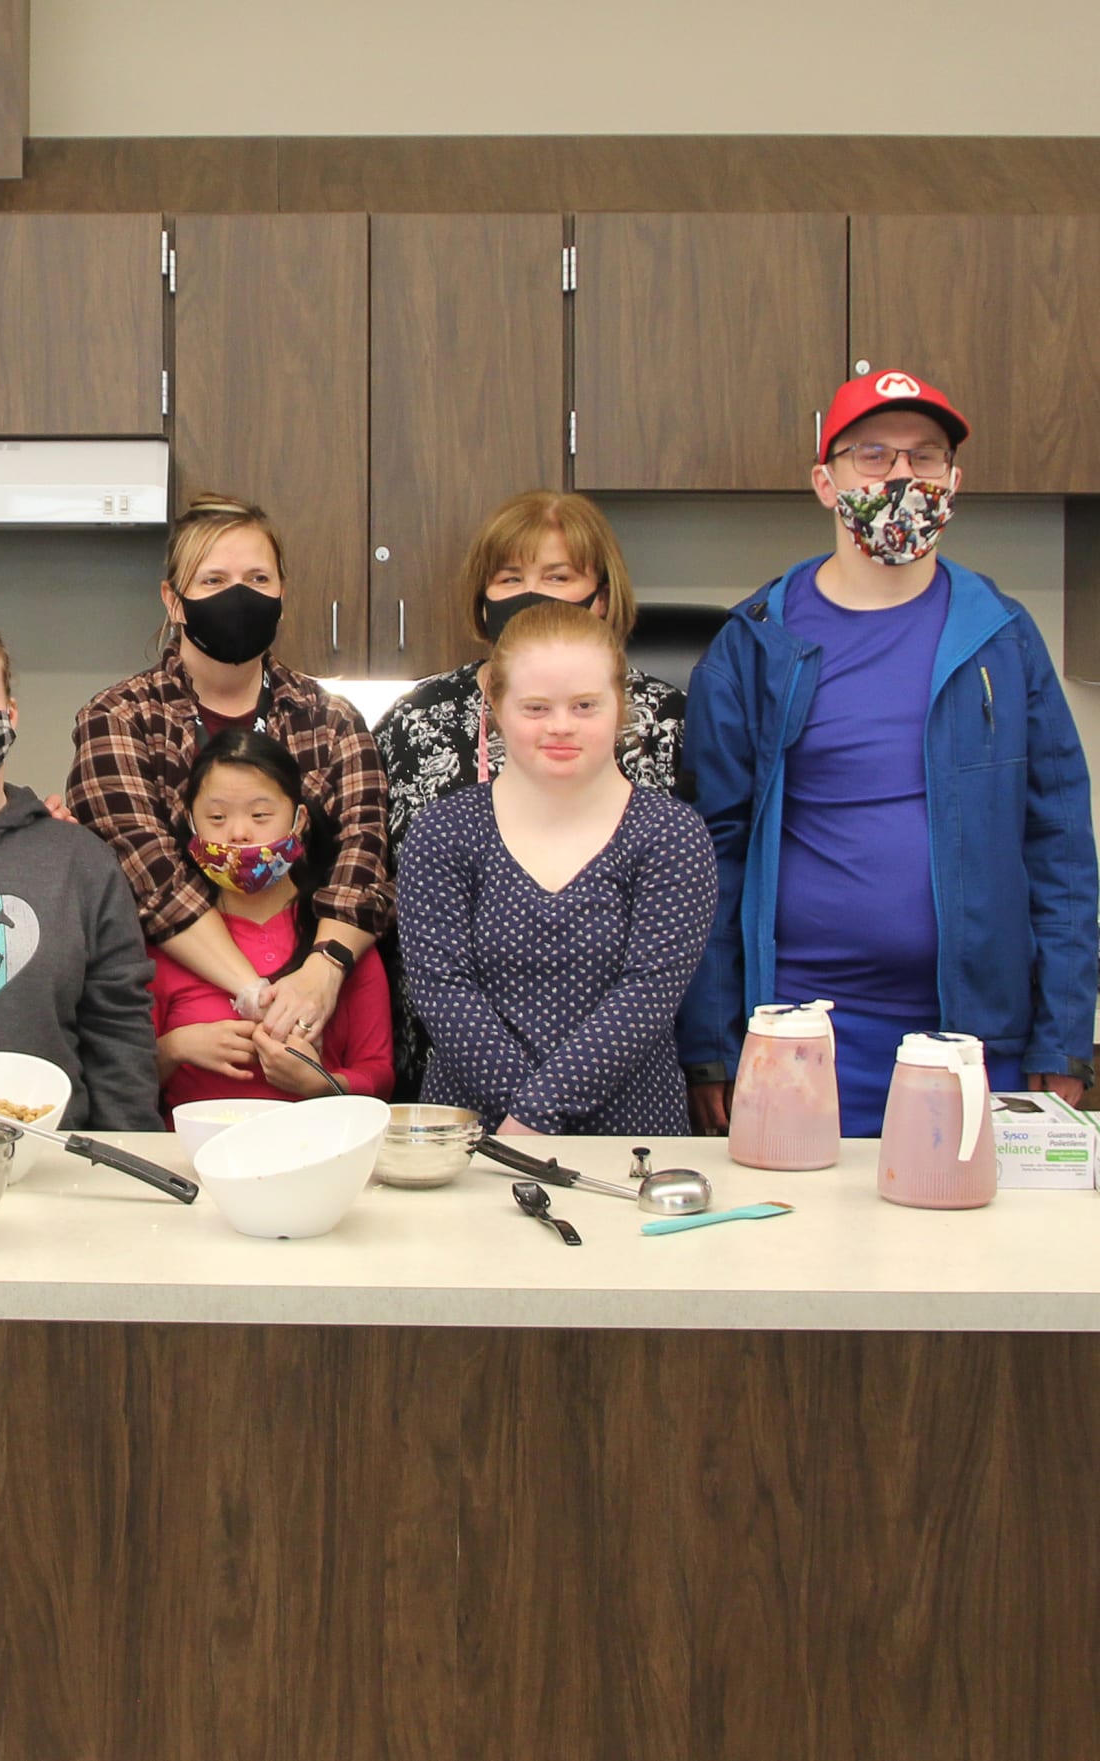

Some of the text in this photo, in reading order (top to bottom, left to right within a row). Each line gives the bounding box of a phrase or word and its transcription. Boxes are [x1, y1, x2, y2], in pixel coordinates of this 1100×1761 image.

[881, 377, 916, 391] M
[1002, 1130, 1029, 1141] Sysco
[1078, 1130, 1088, 1138] de
[995, 1142, 1042, 1155] eliance
